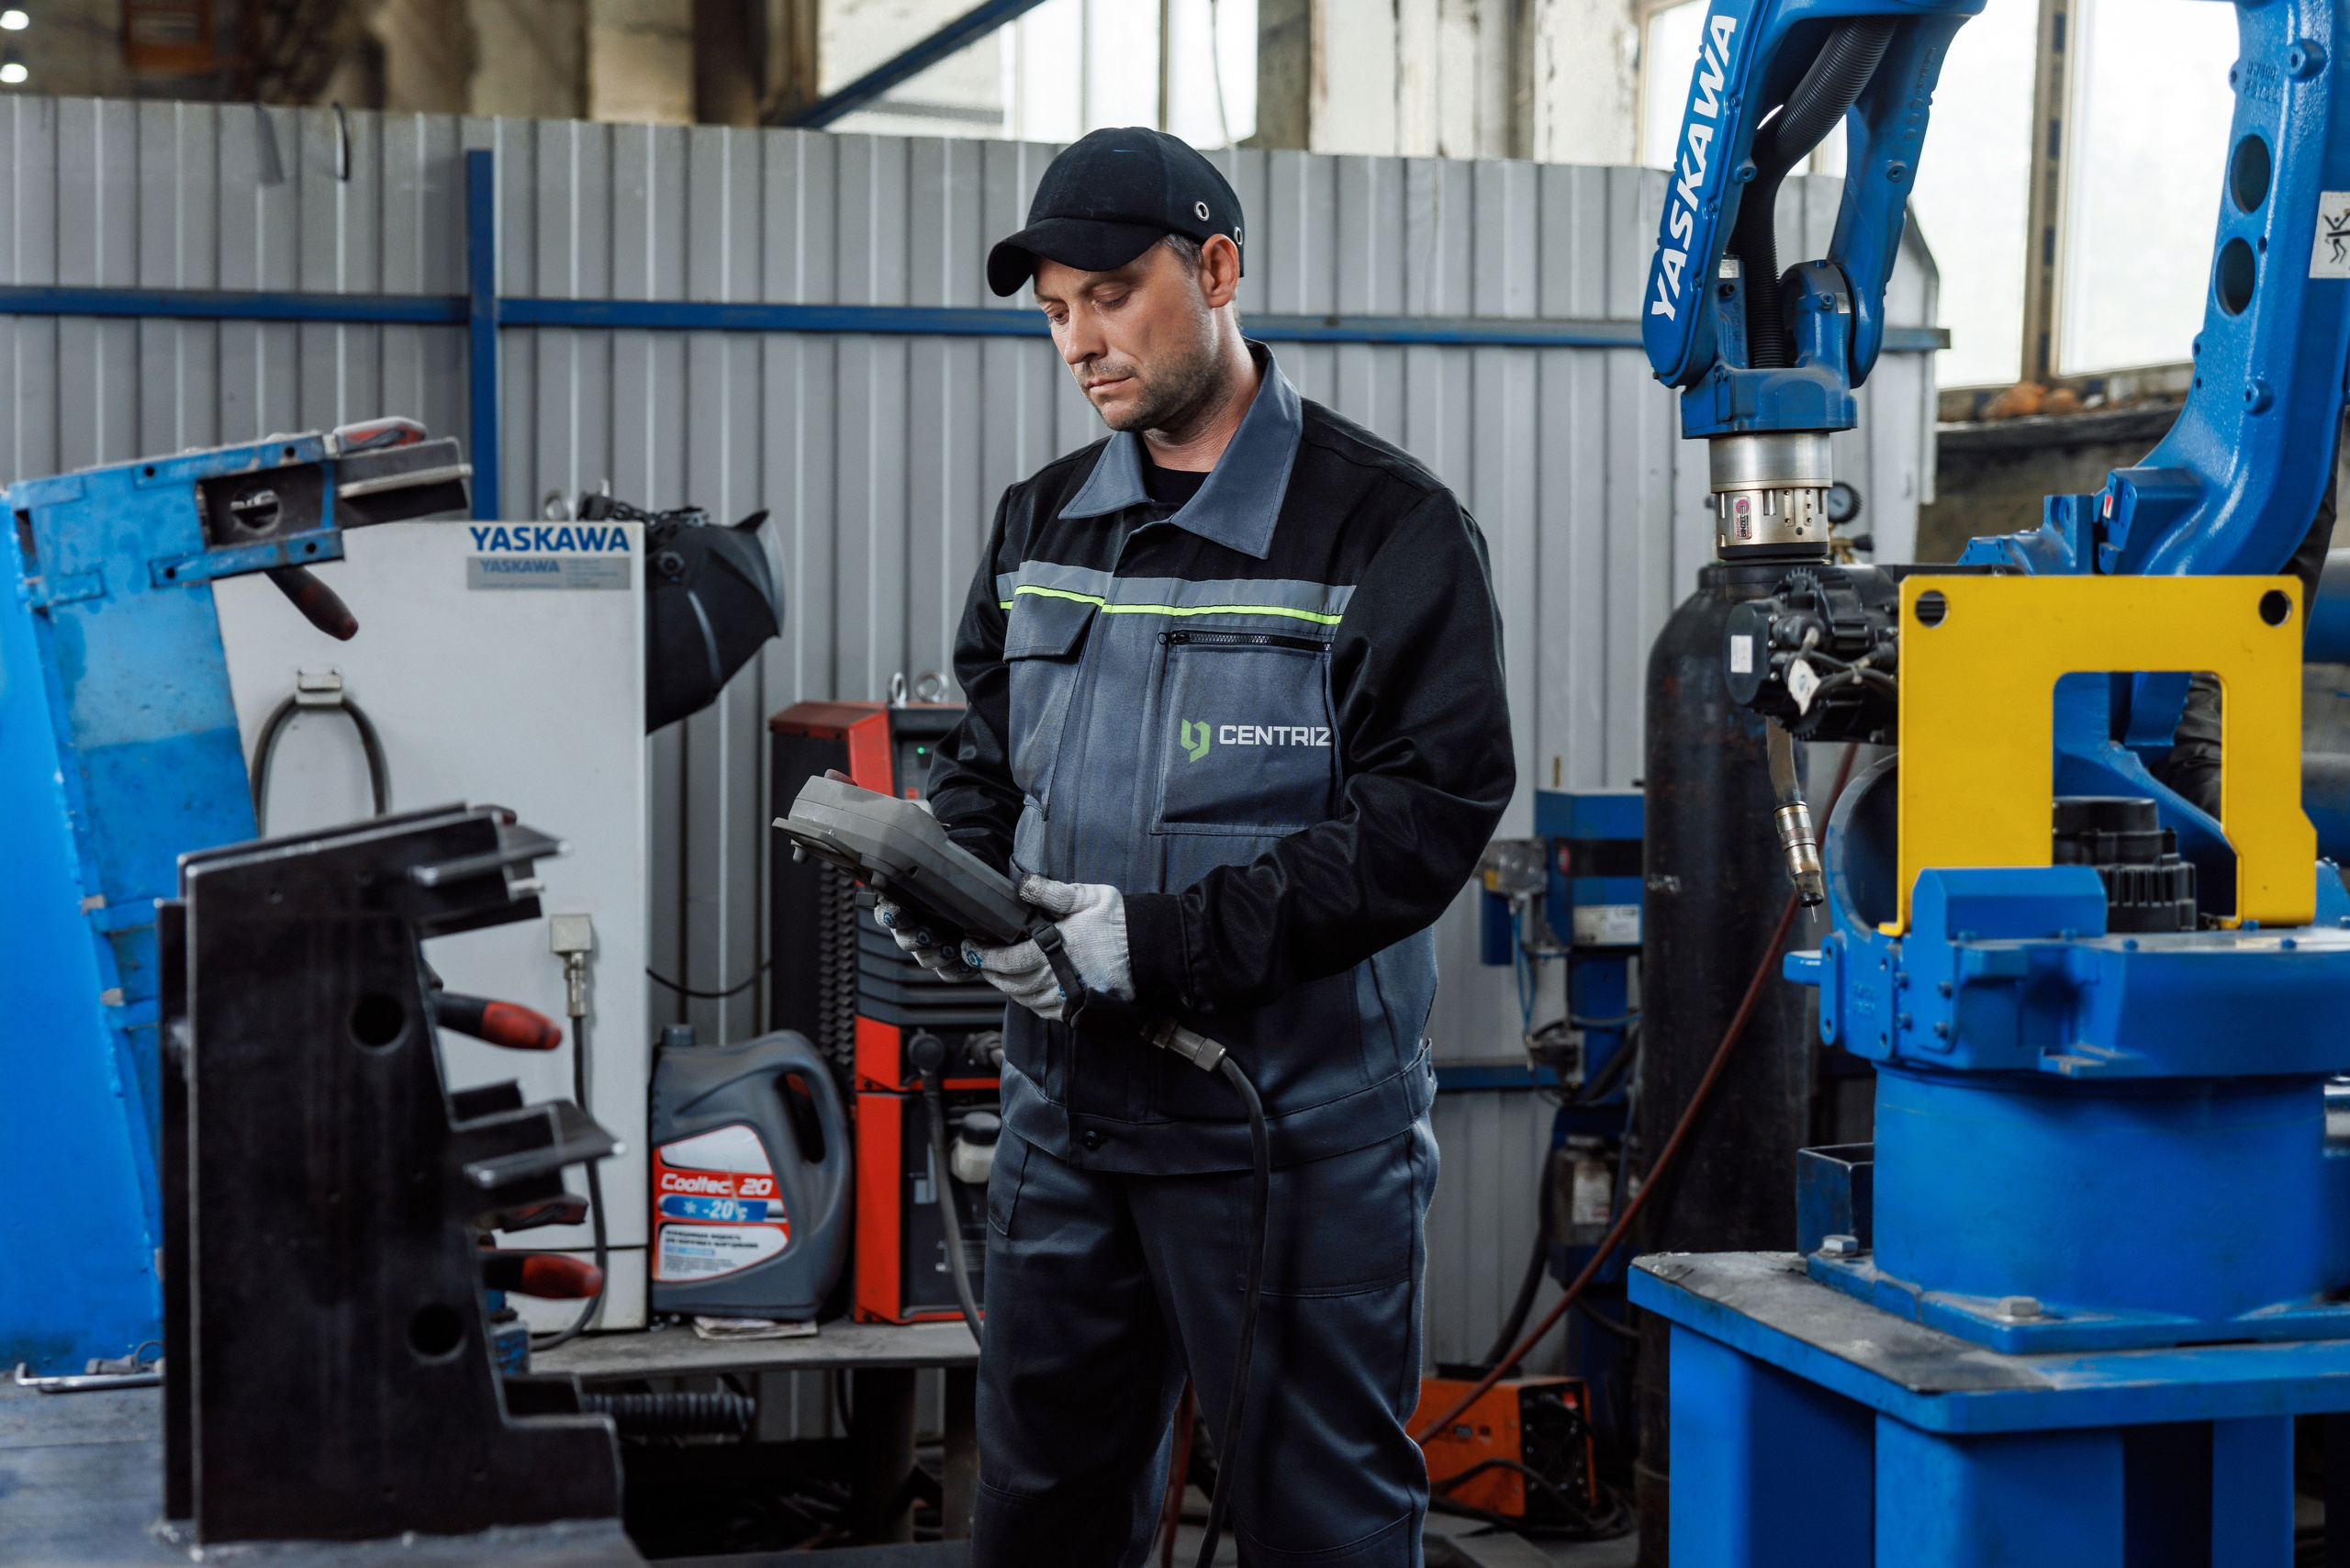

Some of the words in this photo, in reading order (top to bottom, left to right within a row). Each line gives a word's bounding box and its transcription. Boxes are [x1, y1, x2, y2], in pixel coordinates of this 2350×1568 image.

[1651, 15, 1738, 321] YASKAWA
[469, 526, 631, 552] YASKAWA
[479, 559, 560, 573] YASKAWA
[1219, 724, 1333, 746] CENTRIZ
[661, 1172, 733, 1194] Cooltec
[739, 1178, 773, 1196] 20
